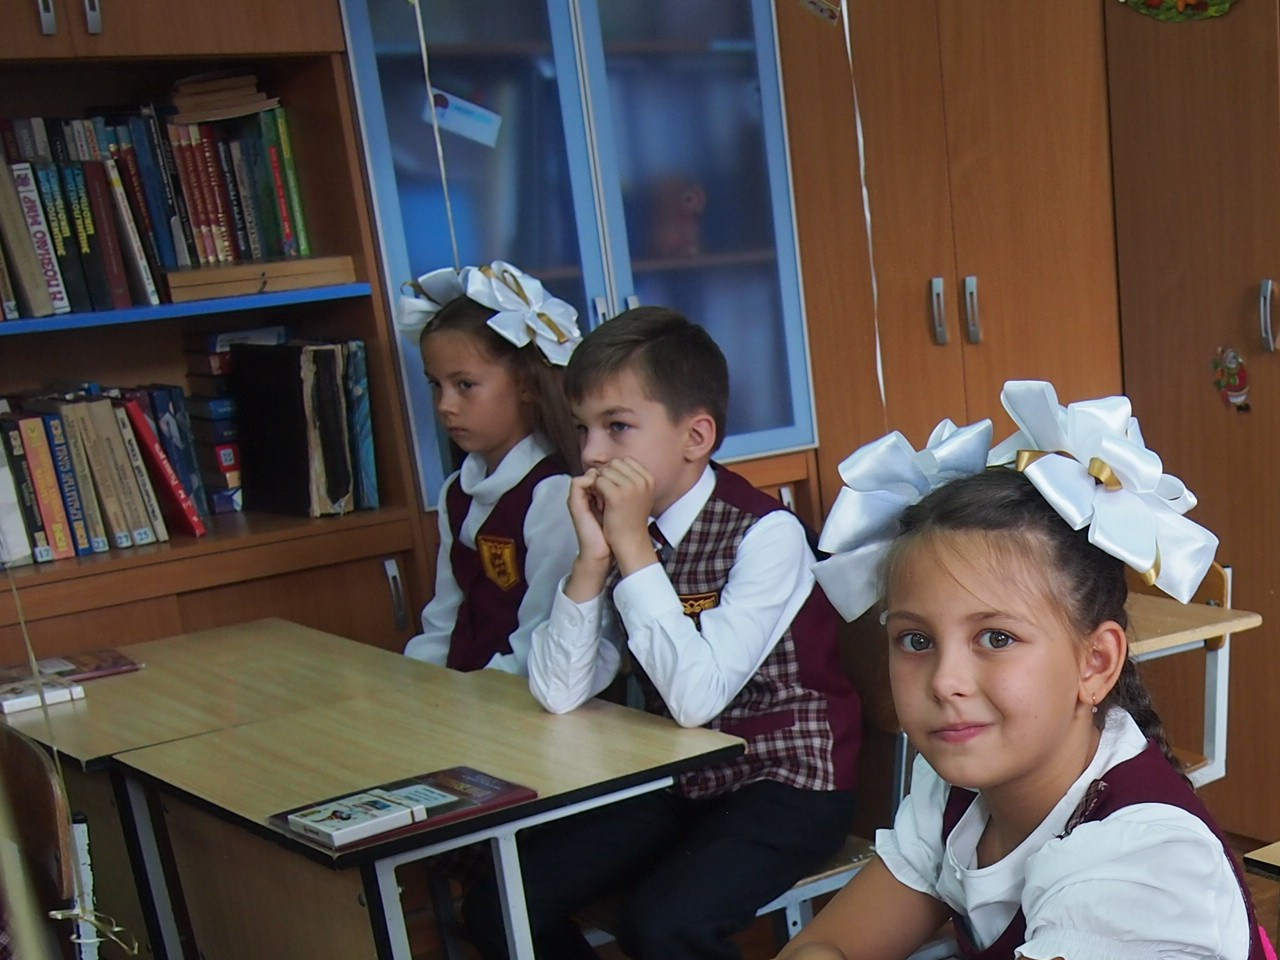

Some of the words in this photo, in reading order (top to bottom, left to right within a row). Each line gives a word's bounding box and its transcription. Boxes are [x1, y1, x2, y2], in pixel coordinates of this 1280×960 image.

[22, 194, 42, 227] МИР
[33, 229, 61, 289] ПОЗНАЮ
[49, 290, 65, 302] Я
